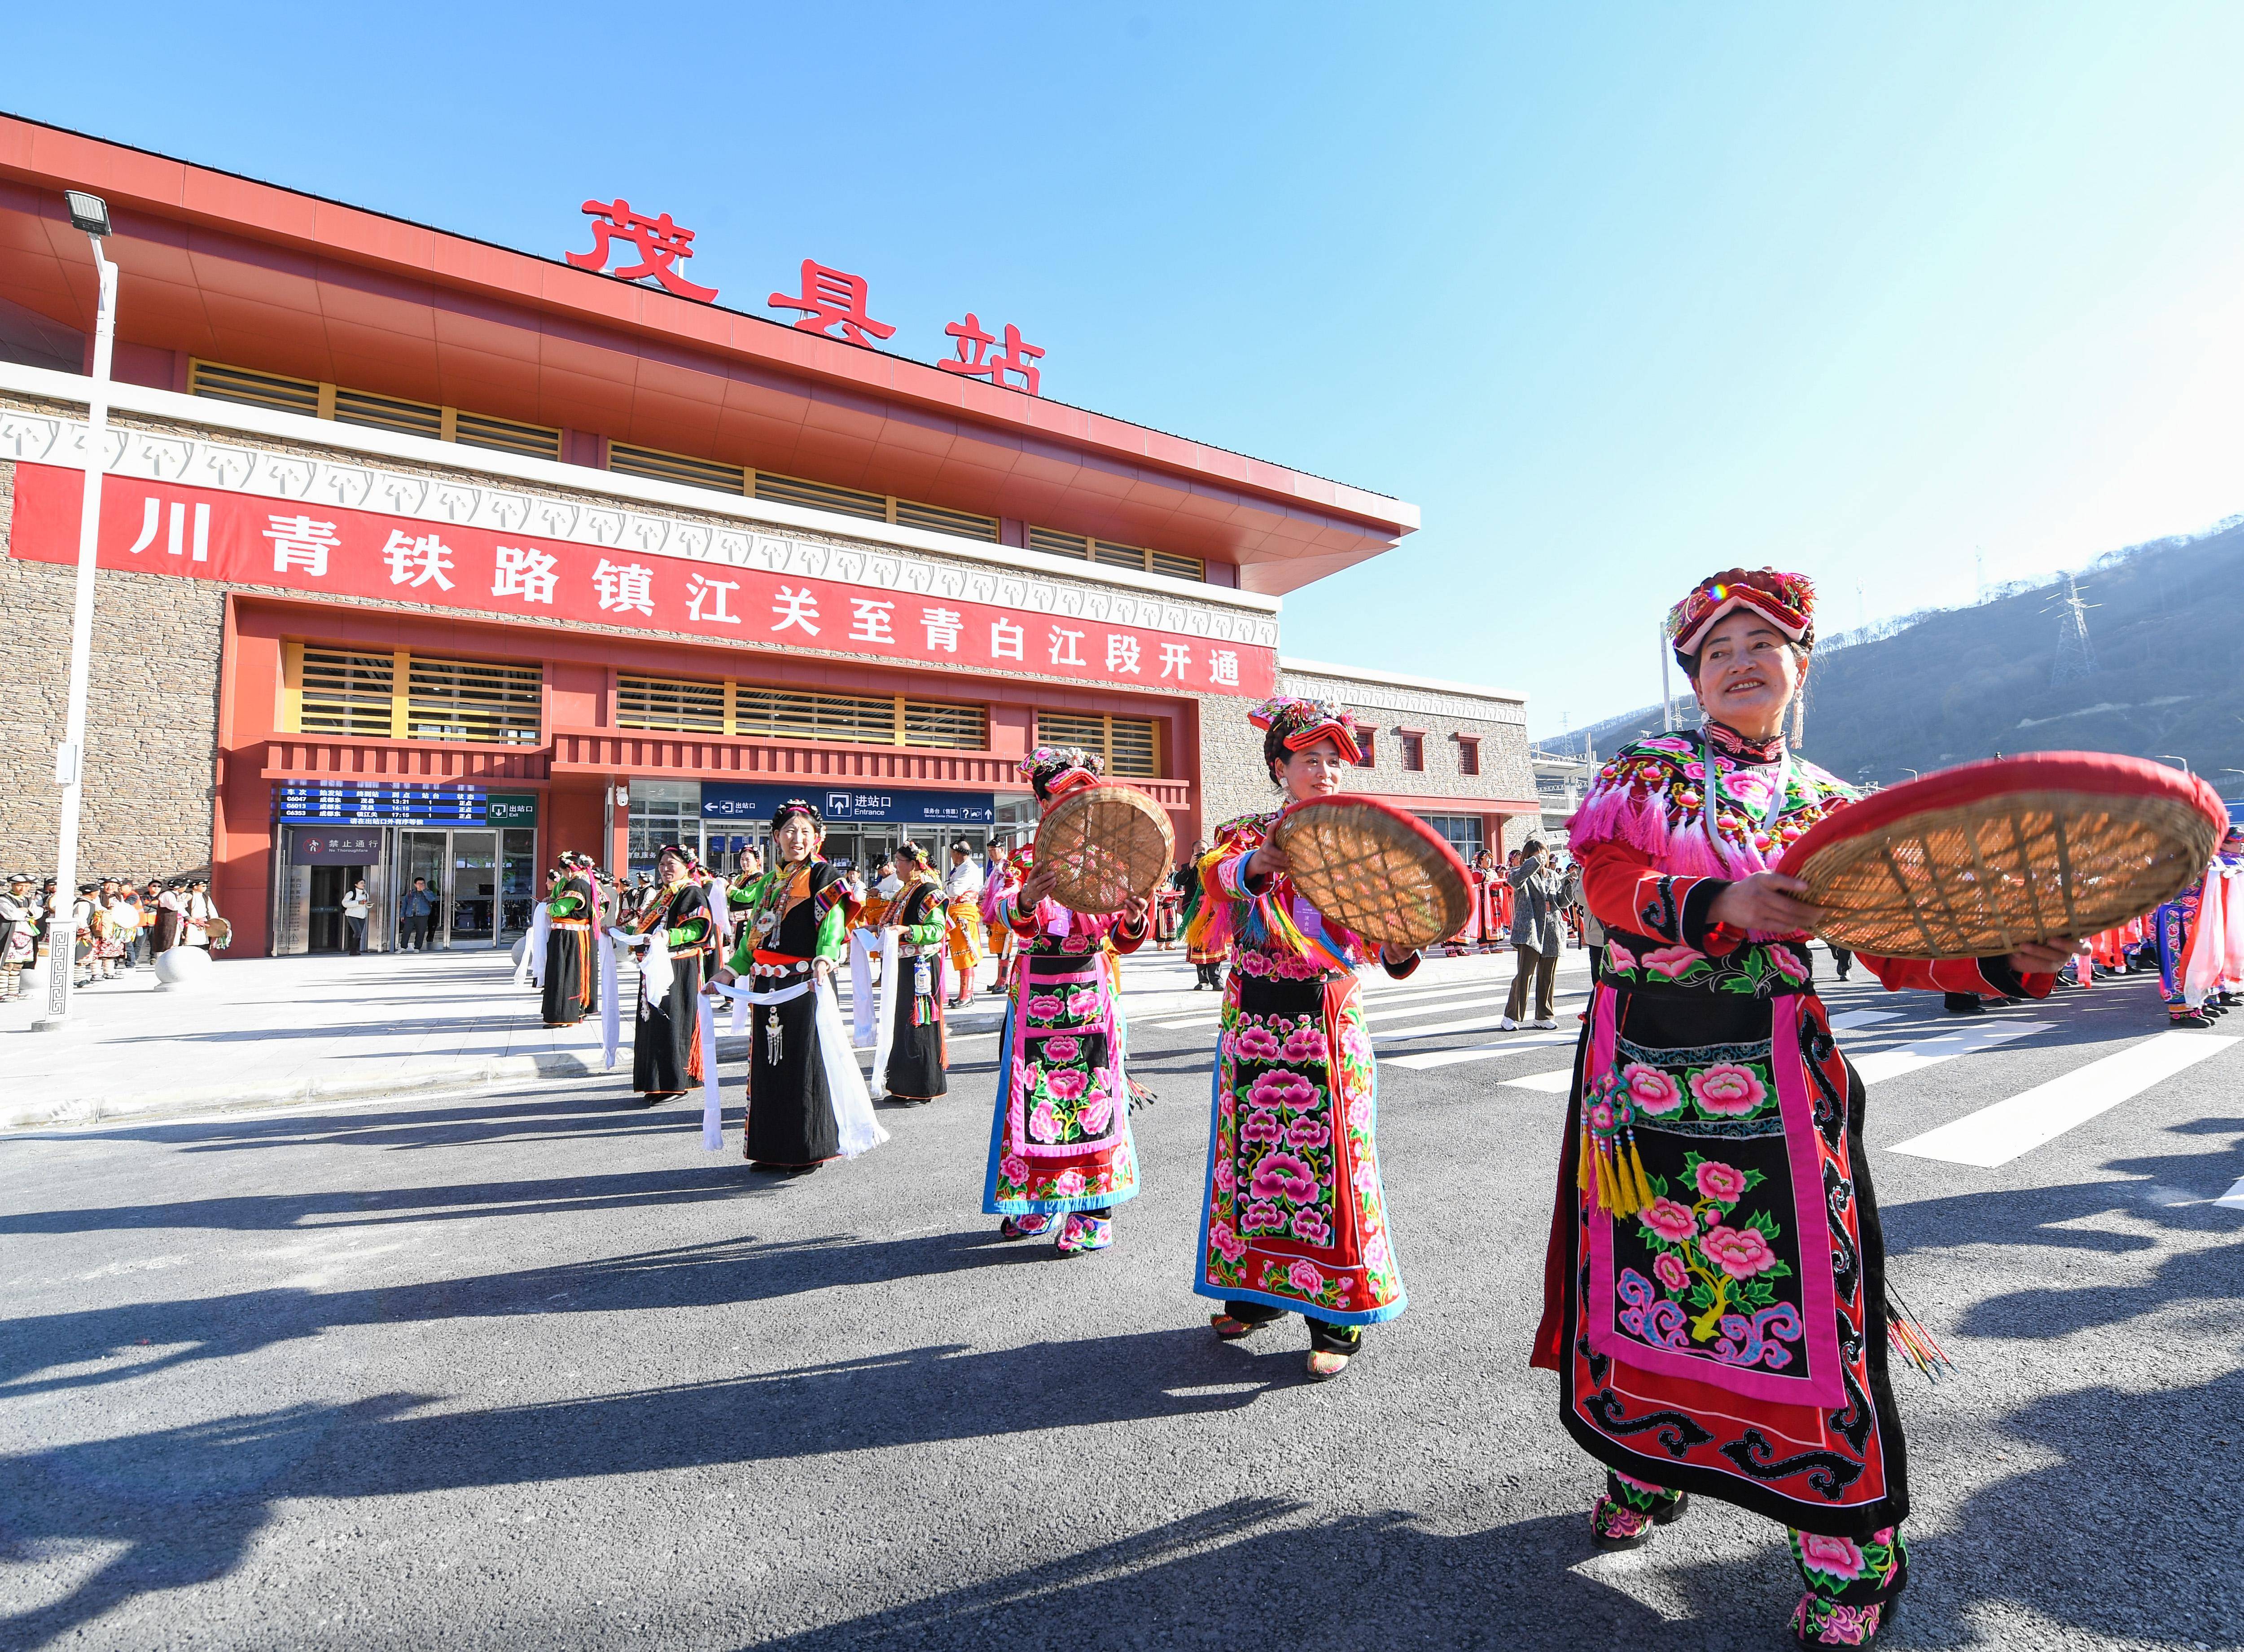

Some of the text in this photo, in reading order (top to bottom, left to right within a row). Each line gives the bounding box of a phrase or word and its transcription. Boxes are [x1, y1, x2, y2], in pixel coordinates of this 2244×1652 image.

[565, 198, 1045, 397] 茂县站
[129, 497, 1240, 687] 川青铁路镇江关至青白江段开通
[329, 839, 378, 848] 禁止通行
[855, 795, 891, 807] 进站口
